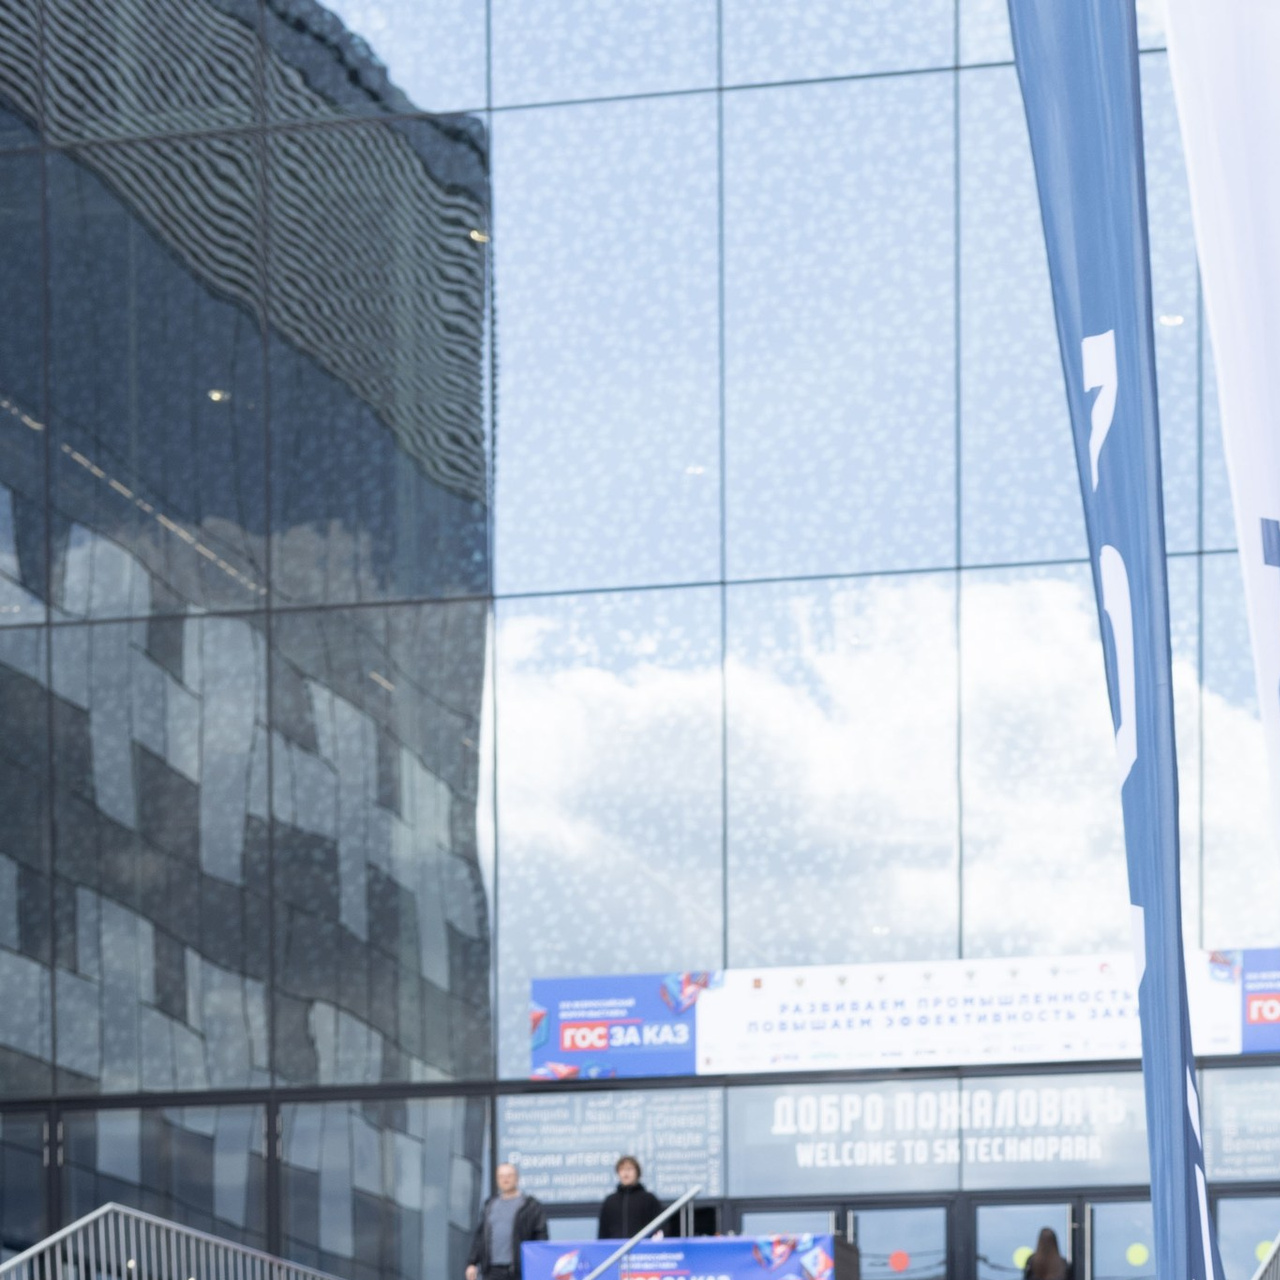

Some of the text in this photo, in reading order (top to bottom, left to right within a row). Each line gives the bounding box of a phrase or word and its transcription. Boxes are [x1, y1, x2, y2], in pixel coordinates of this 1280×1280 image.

[778, 990, 1133, 1015] РАЗВИВАЕМ ПРОМЫШЛЕННОСТЬ
[748, 1016, 873, 1033] ПОВЫШАЕМ
[885, 1009, 1076, 1029] ЭФФЕКТИВНОСТЬ
[563, 1027, 608, 1048] ГОС
[771, 1086, 1126, 1135] ДОБРО ПОЖАЛОВАТЬ
[795, 1141, 898, 1168] WELCOME
[902, 1139, 928, 1165] TO
